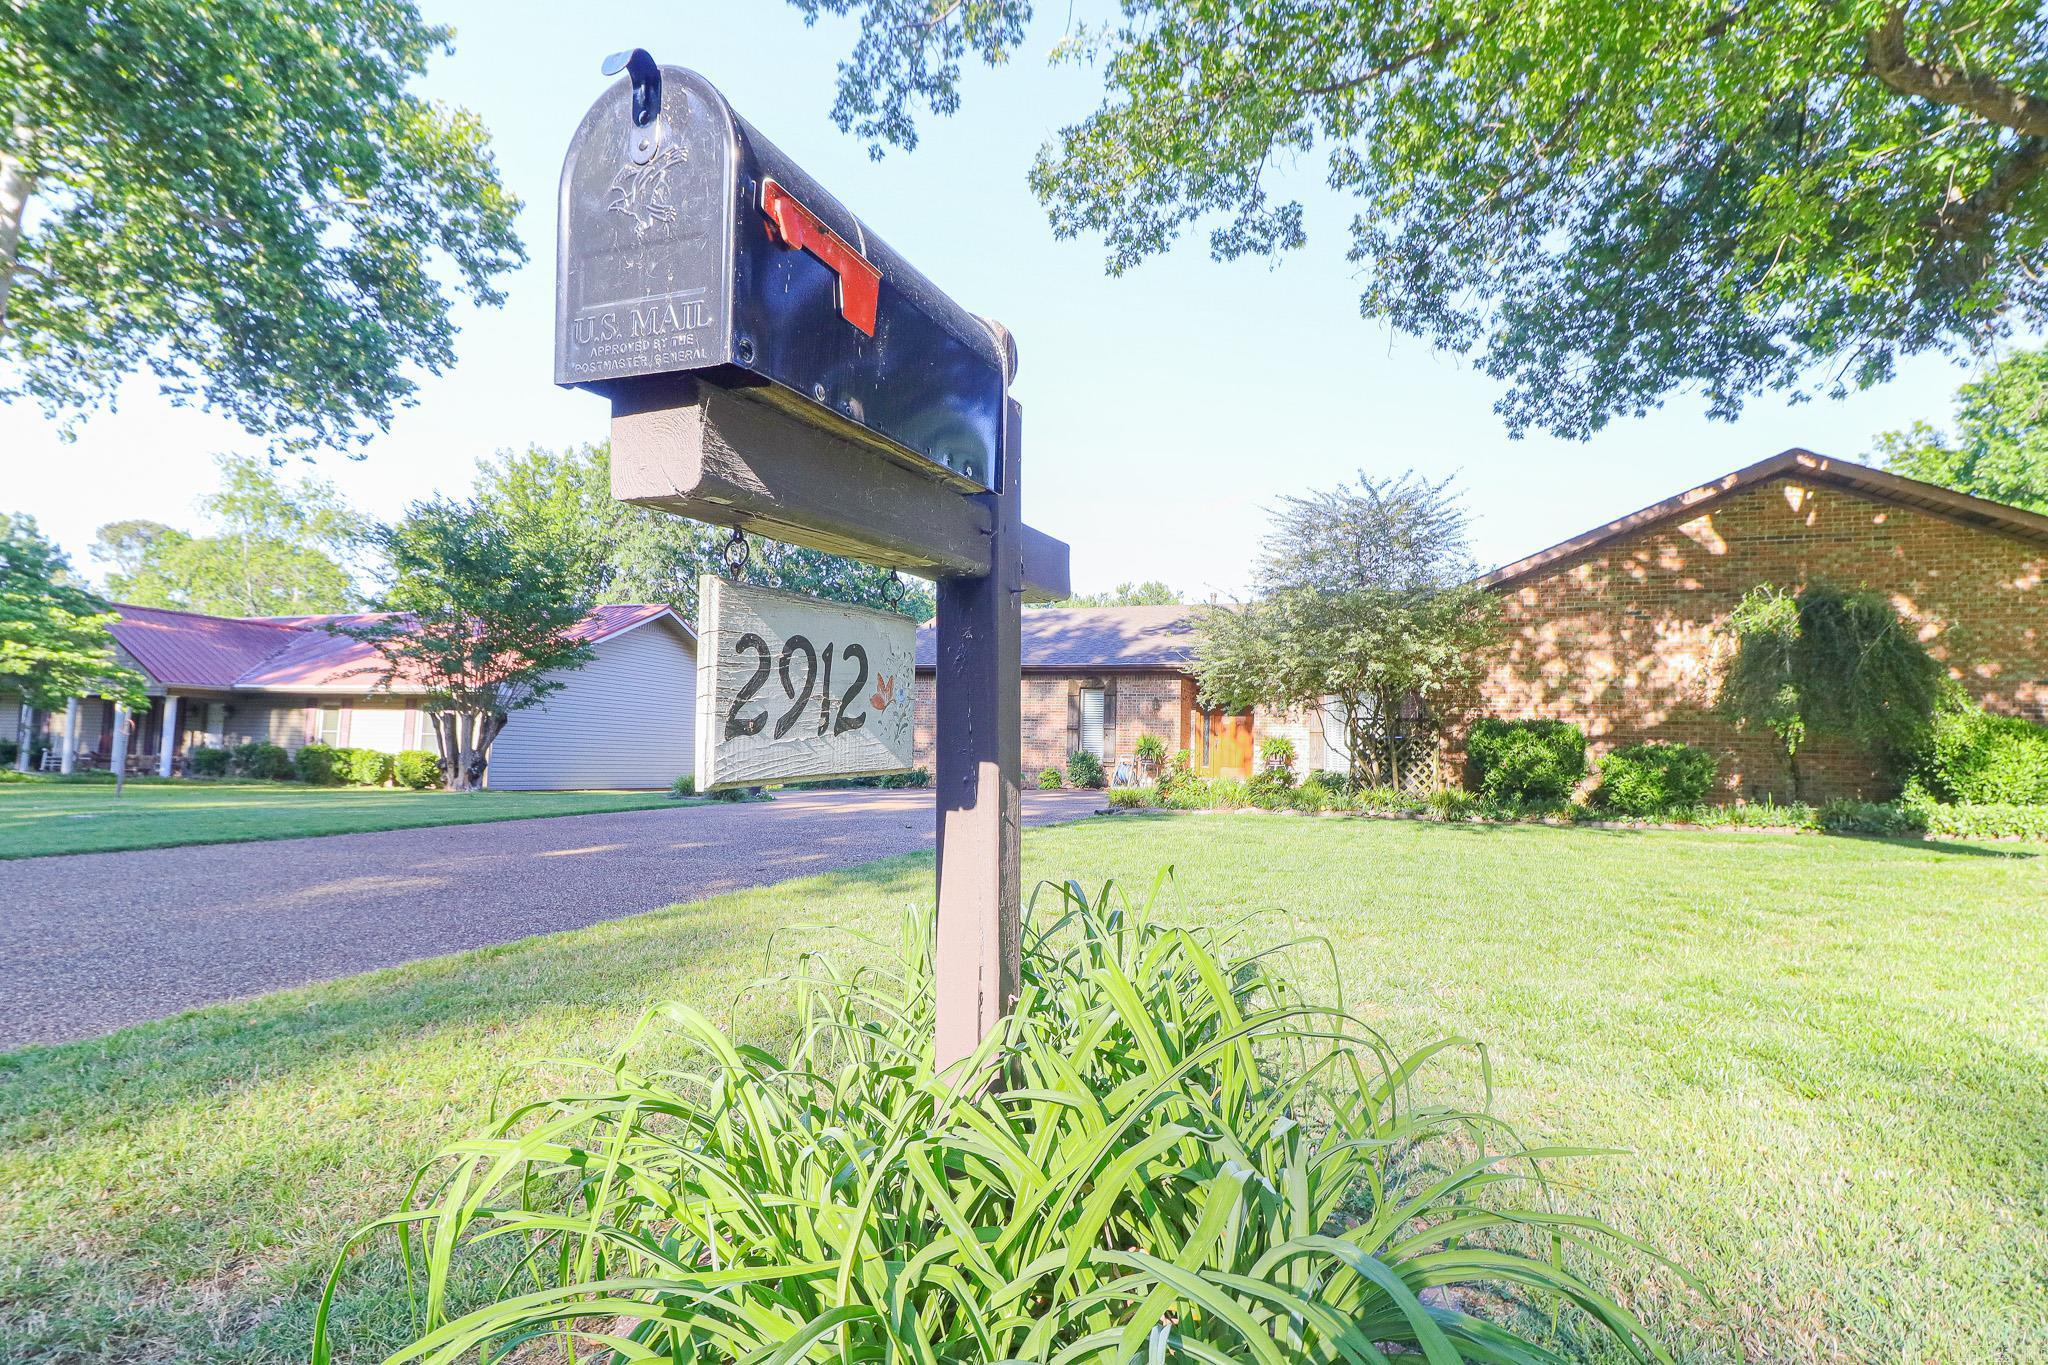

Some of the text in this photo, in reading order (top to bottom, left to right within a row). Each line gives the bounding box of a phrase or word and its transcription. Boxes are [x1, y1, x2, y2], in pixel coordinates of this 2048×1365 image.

[630, 300, 712, 337] MAIL
[574, 348, 707, 373] POSTMASTER GENERAL
[590, 333, 694, 358] APPROVED BY THE
[725, 632, 869, 742] 2912
